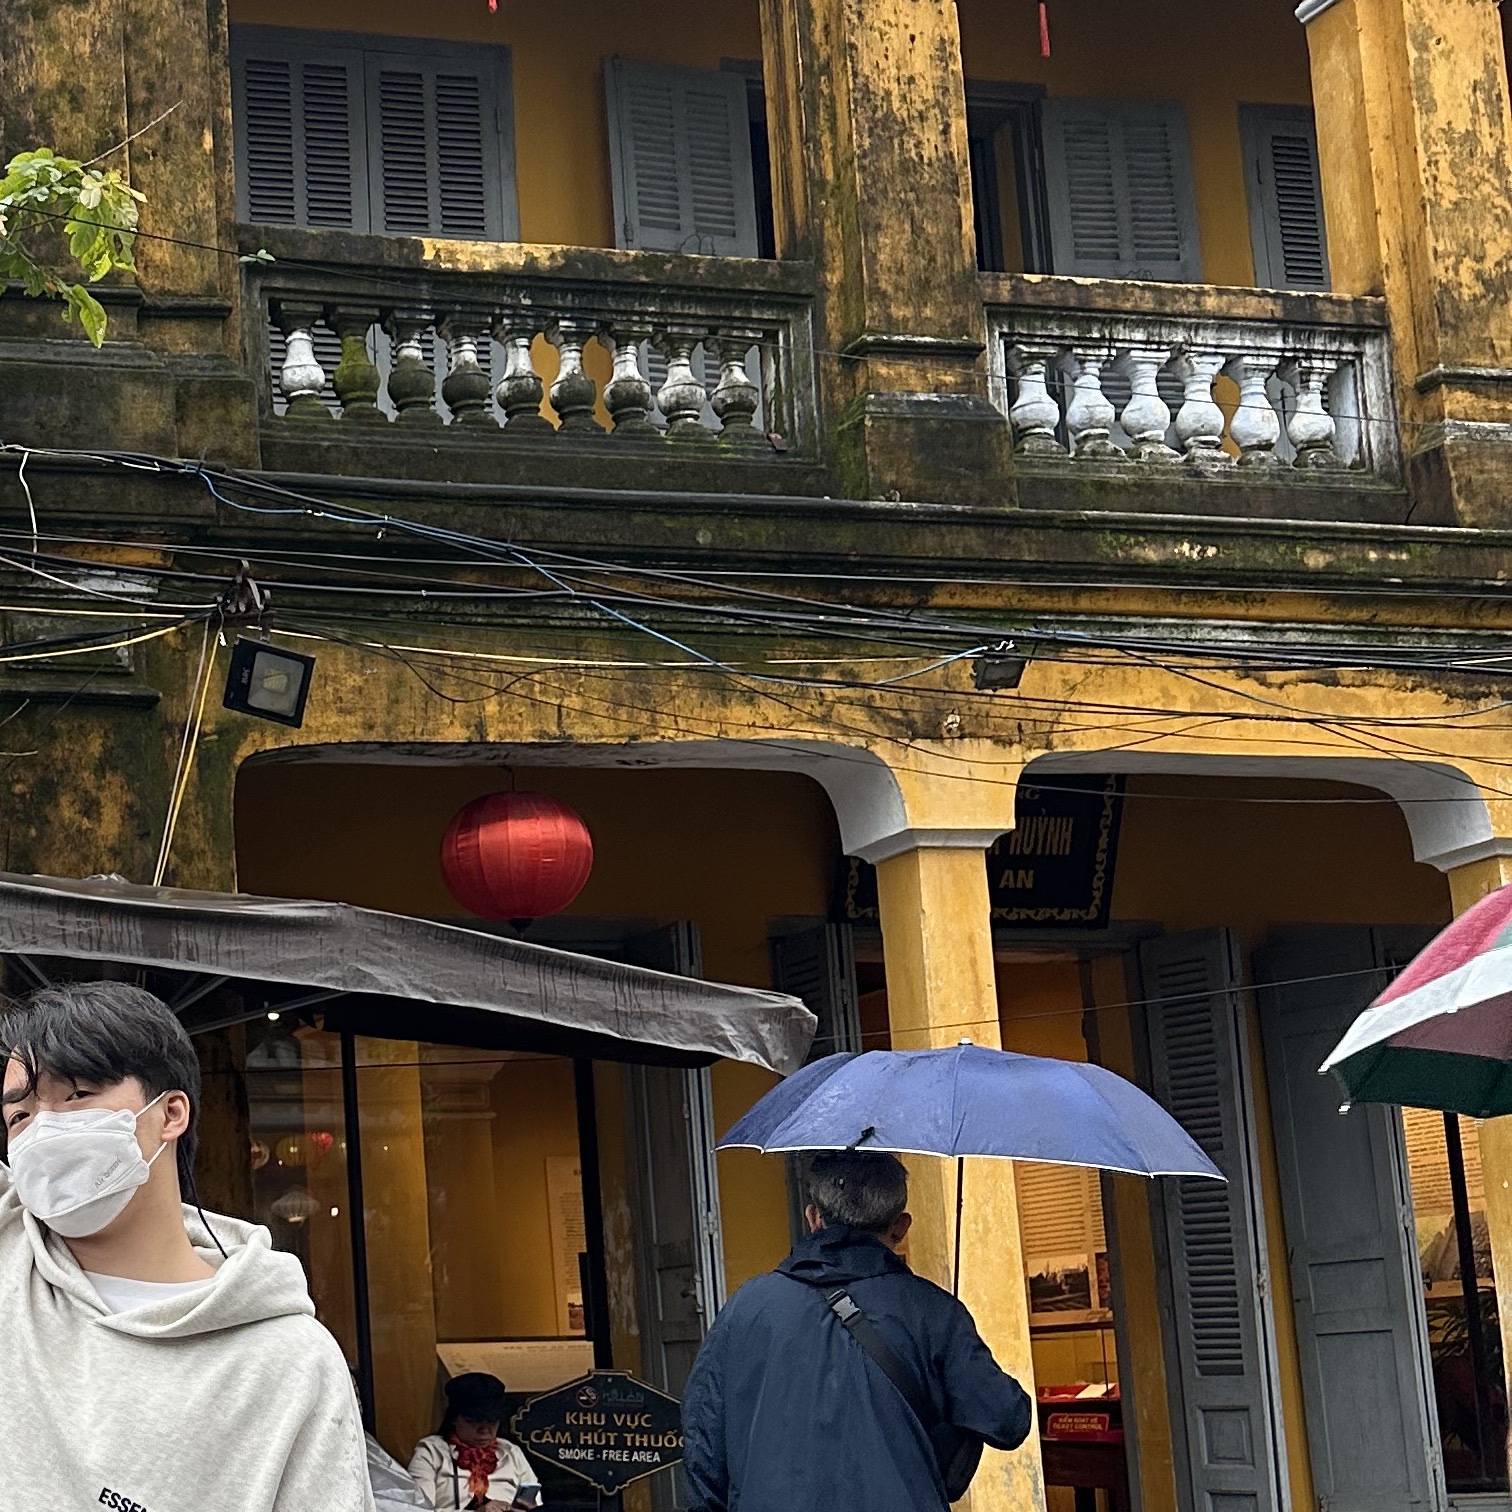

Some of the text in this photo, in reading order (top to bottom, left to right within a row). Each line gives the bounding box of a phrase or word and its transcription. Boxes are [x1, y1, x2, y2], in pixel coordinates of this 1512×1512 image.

[999, 869, 1034, 889] AN
[565, 1411, 653, 1428] KHU VỰC
[530, 1424, 572, 1445] CẤM
[579, 1427, 618, 1446] HÚT
[558, 1448, 595, 1460] SMOKE
[602, 1450, 630, 1462] FREE
[631, 1450, 661, 1463] AREA
